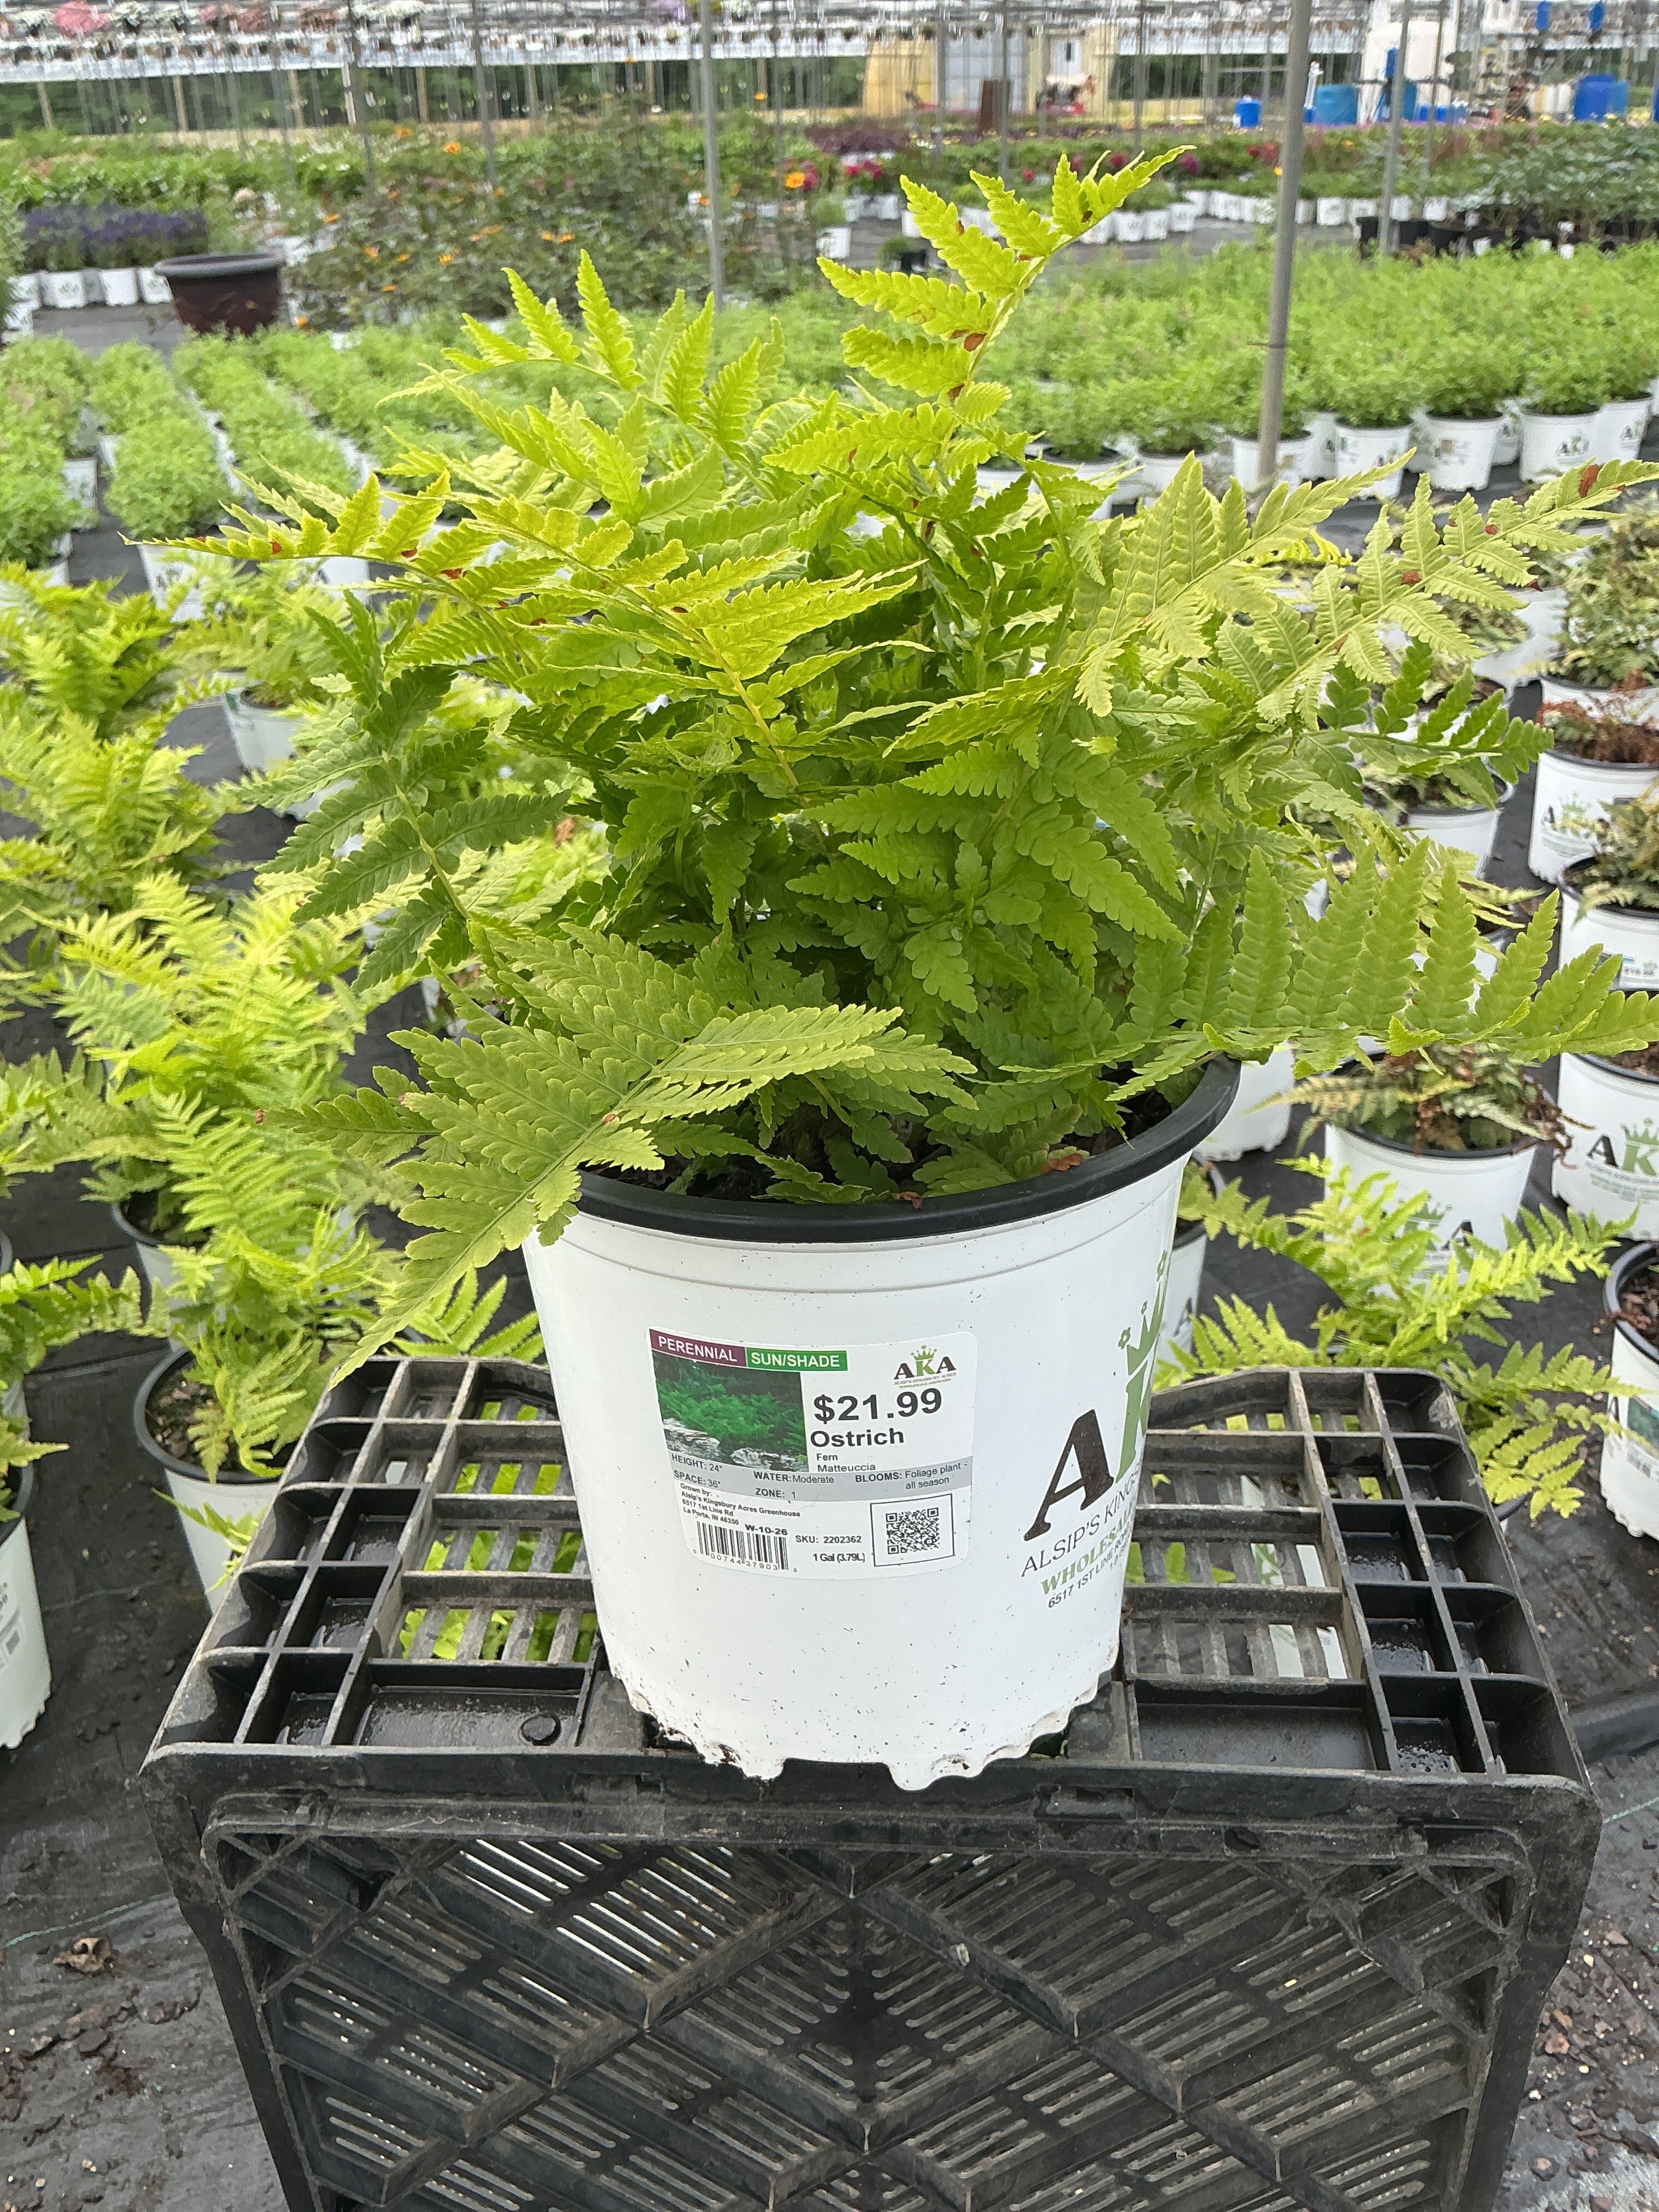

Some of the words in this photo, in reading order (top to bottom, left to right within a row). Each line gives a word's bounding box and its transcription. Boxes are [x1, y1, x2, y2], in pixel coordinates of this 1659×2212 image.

[658, 1335, 737, 1362] PERENNIAL
[751, 1352, 840, 1367] SUN/SHADE
[894, 1356, 956, 1380] AKA
[814, 1388, 942, 1424] $21.99
[810, 1427, 904, 1447] Ostrich
[672, 1453, 707, 1469] HEIGHT:
[709, 1463, 723, 1472] 24"
[816, 1453, 838, 1462] Fern
[817, 1463, 876, 1472] Matteuccia
[855, 1472, 902, 1482] BLOOMS:
[905, 1468, 938, 1479] Foliage
[940, 1463, 961, 1475] plant
[674, 1470, 706, 1485] SPACE:
[793, 1475, 834, 1483] Moderate
[906, 1481, 916, 1489] all
[918, 1477, 950, 1488] season
[680, 1482, 701, 1493] Grown
[702, 1488, 712, 1497] by:
[755, 1487, 785, 1498] ZONE:
[703, 1497, 736, 1510] Kingsbury
[738, 1504, 758, 1513] Acres
[759, 1507, 801, 1517] Greenhouse
[744, 1523, 788, 1536] W-10-26
[795, 1535, 819, 1543] SKU:
[823, 1536, 862, 1544] 2202362
[1021, 1514, 1100, 1577] ALSIP'S
[746, 1560, 778, 1571] 37903
[813, 1553, 818, 1561] 1
[820, 1553, 835, 1562] Gal
[837, 1553, 866, 1564] (3.79L)
[1048, 1584, 1074, 1608] 6517
[1077, 1567, 1094, 1589] 1ST
[1096, 1547, 1114, 1574] LINE
